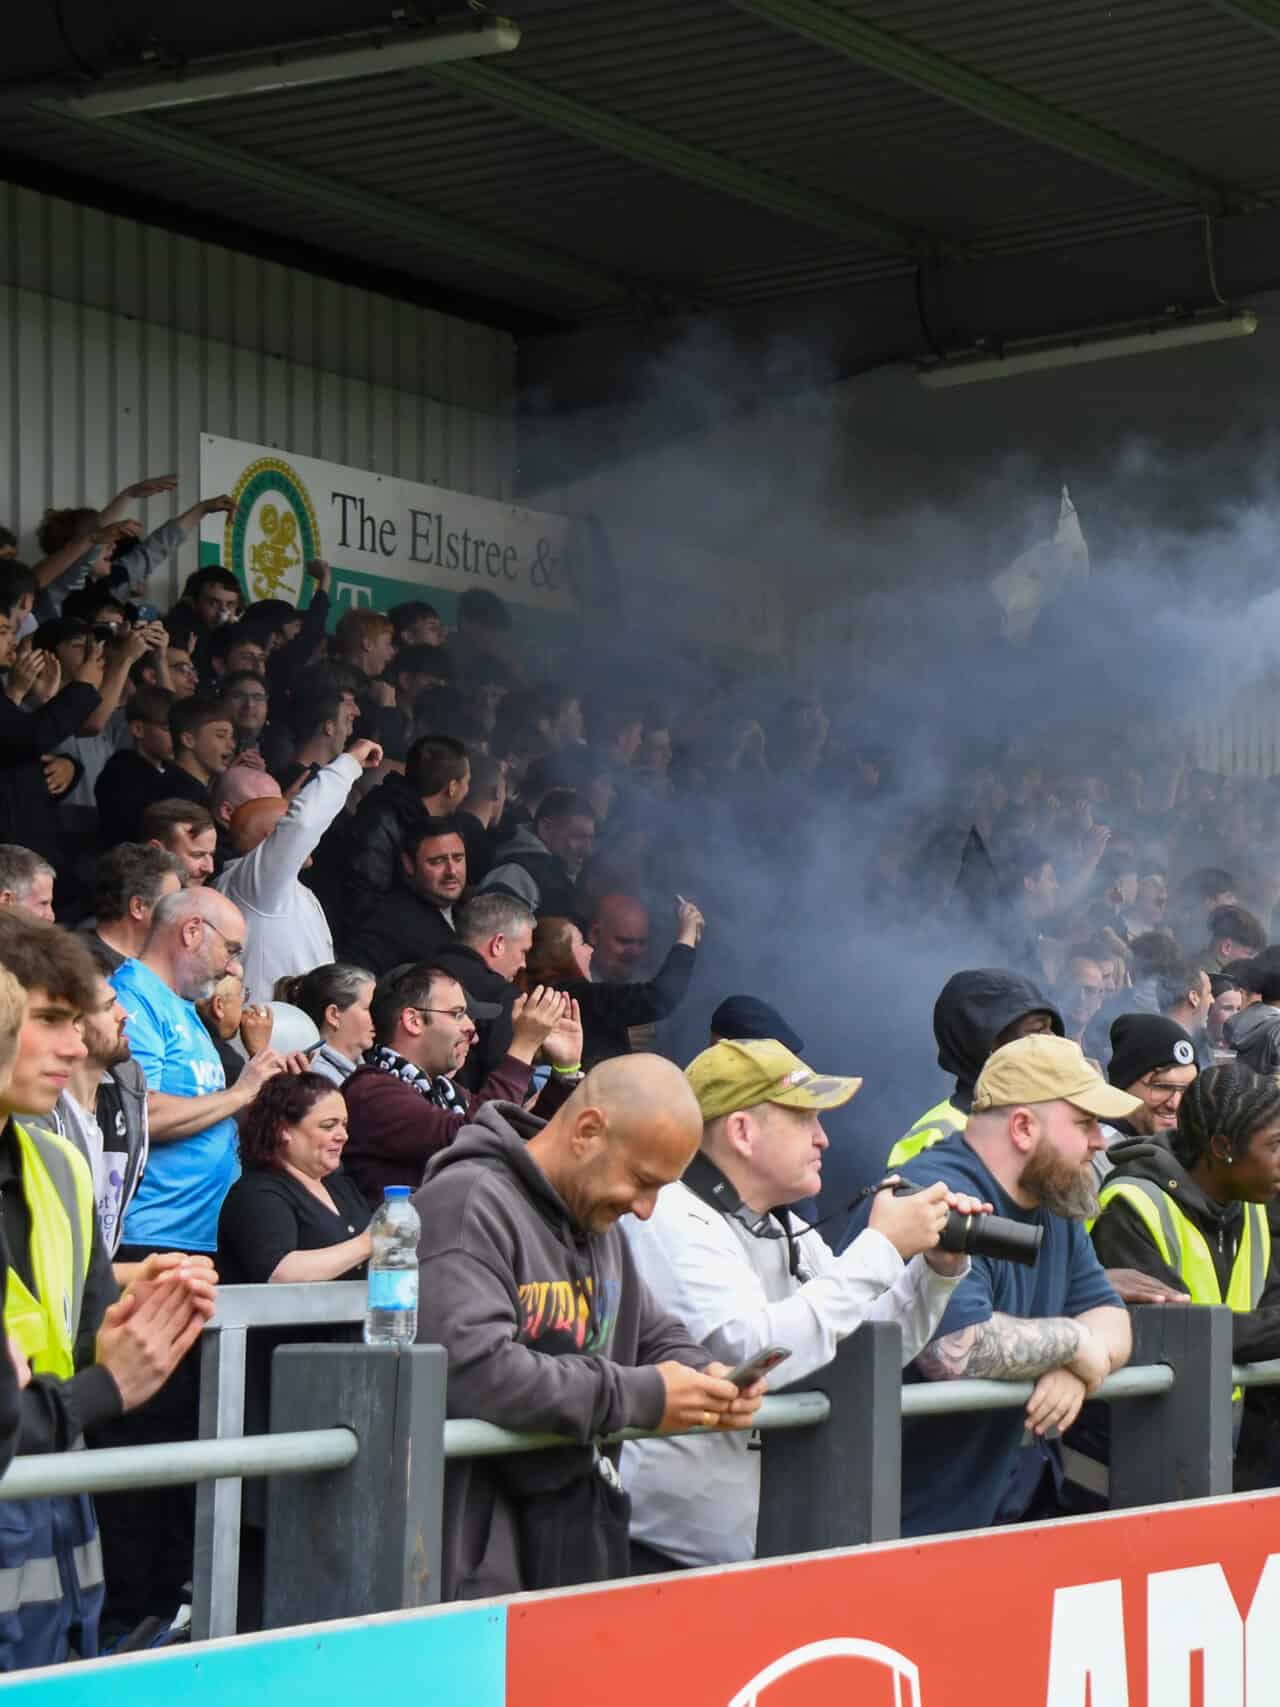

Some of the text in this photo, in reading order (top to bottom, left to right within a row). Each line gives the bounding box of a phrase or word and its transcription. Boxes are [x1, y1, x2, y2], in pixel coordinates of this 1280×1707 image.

[331, 492, 560, 591] The Elstree &
